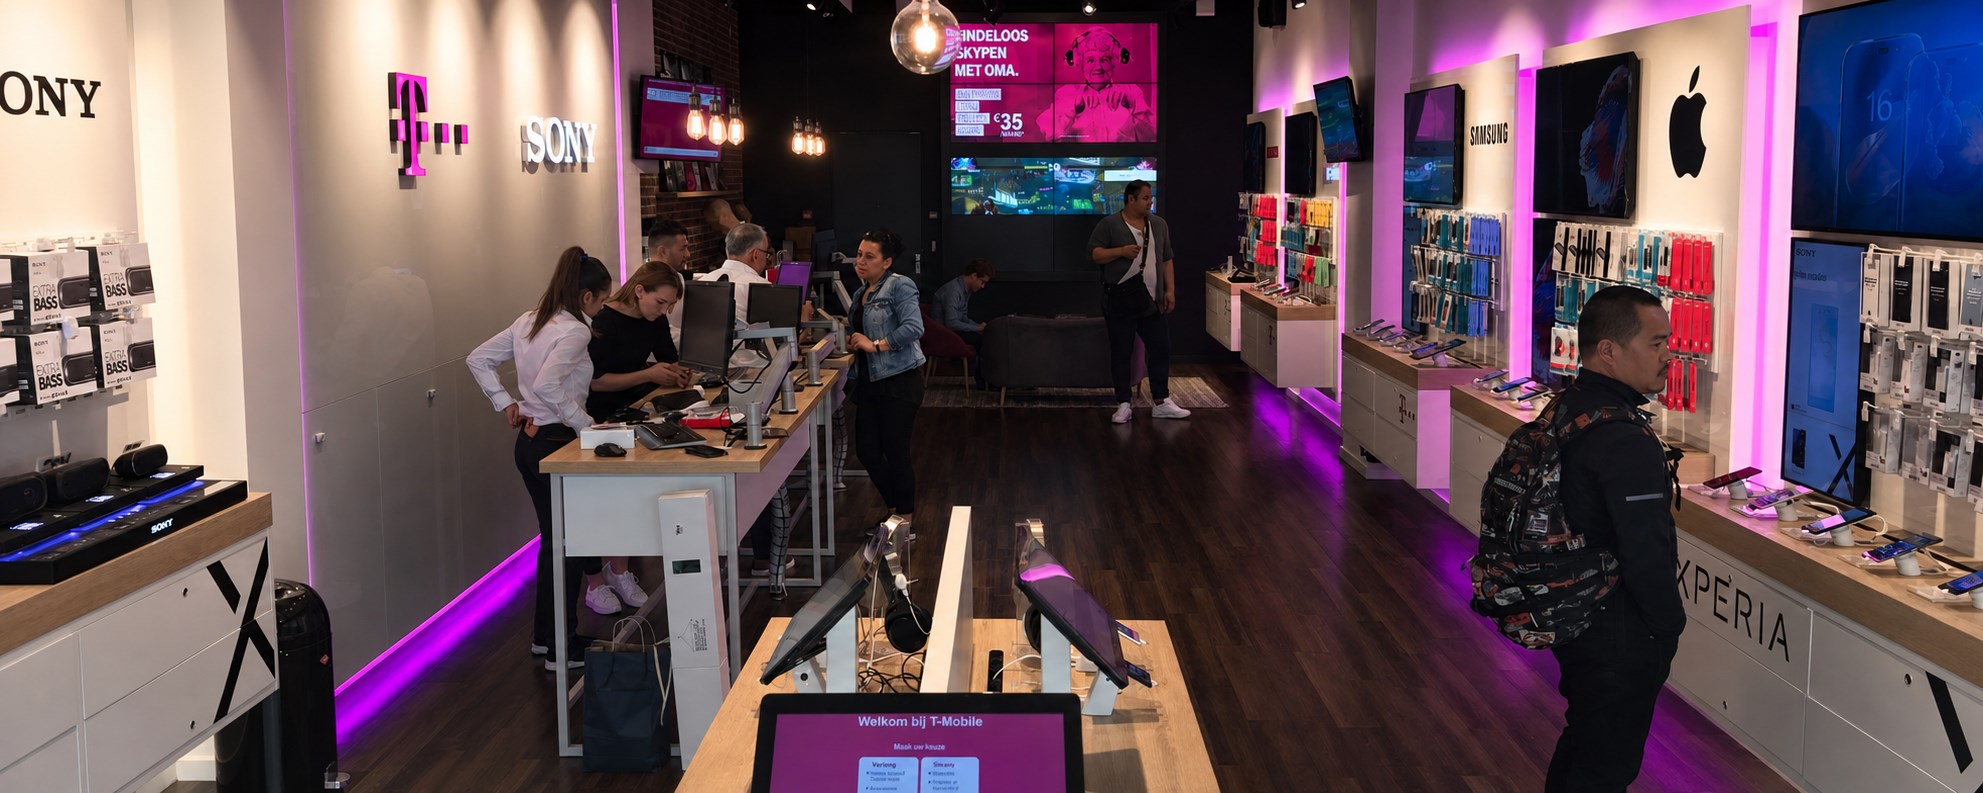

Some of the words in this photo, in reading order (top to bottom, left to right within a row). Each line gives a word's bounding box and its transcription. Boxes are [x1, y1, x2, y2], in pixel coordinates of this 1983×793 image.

[954, 64, 982, 77] MET
[984, 64, 1019, 77] OMA.
[1867, 89, 1892, 122] 16
[524, 115, 597, 164] SONY
[1470, 122, 1509, 146] SAMSUNG
[1796, 248, 1817, 257] SONY
[105, 283, 127, 298] BASS
[34, 296, 58, 312] BASS
[106, 360, 128, 375] BASS
[38, 373, 63, 391] BASS
[151, 517, 173, 534] SONY
[858, 716, 908, 727] Welkom
[911, 716, 927, 730] bij
[930, 716, 983, 727] T-Mobile
